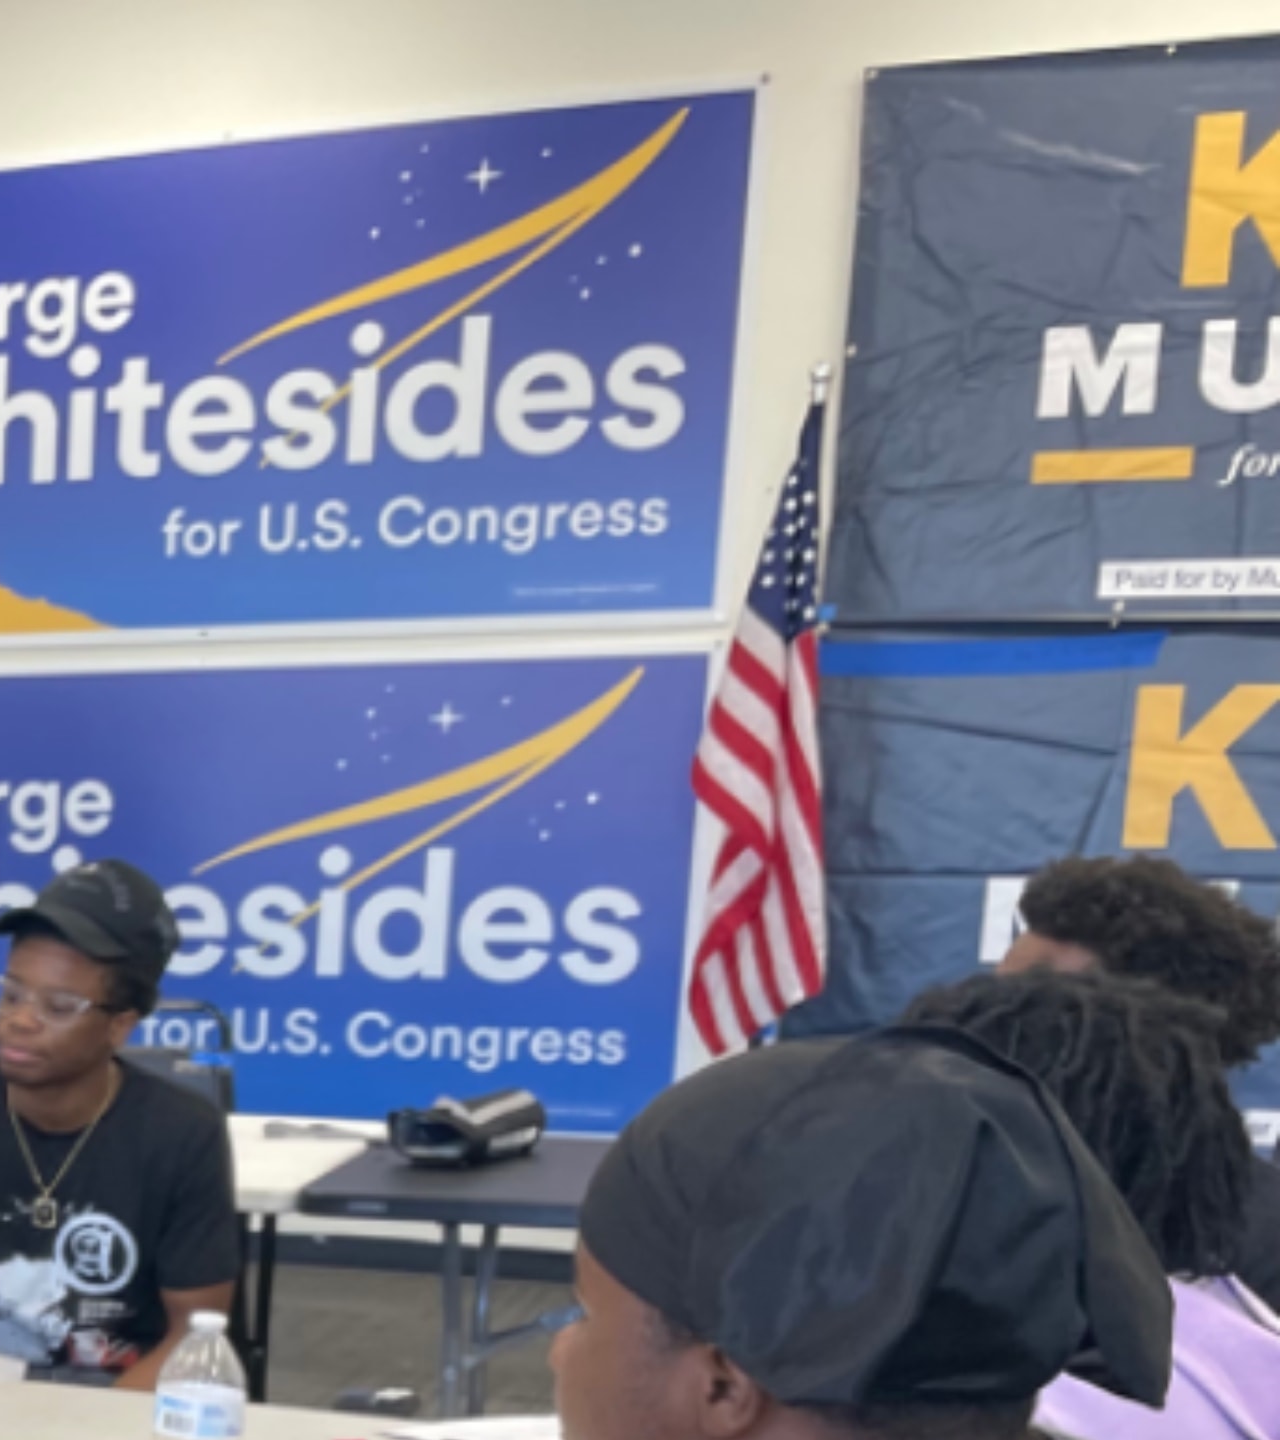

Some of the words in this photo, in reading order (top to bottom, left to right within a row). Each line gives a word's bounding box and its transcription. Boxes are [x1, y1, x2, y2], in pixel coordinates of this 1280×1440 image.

[162, 508, 240, 558] for
[257, 500, 363, 551] U.S.
[377, 494, 670, 556] Congress
[1114, 567, 1169, 590] Paid
[1173, 567, 1207, 590] for
[1211, 567, 1241, 593] by
[142, 1011, 218, 1050] for
[232, 1007, 332, 1056] U.S.
[344, 1010, 627, 1072] Congress
